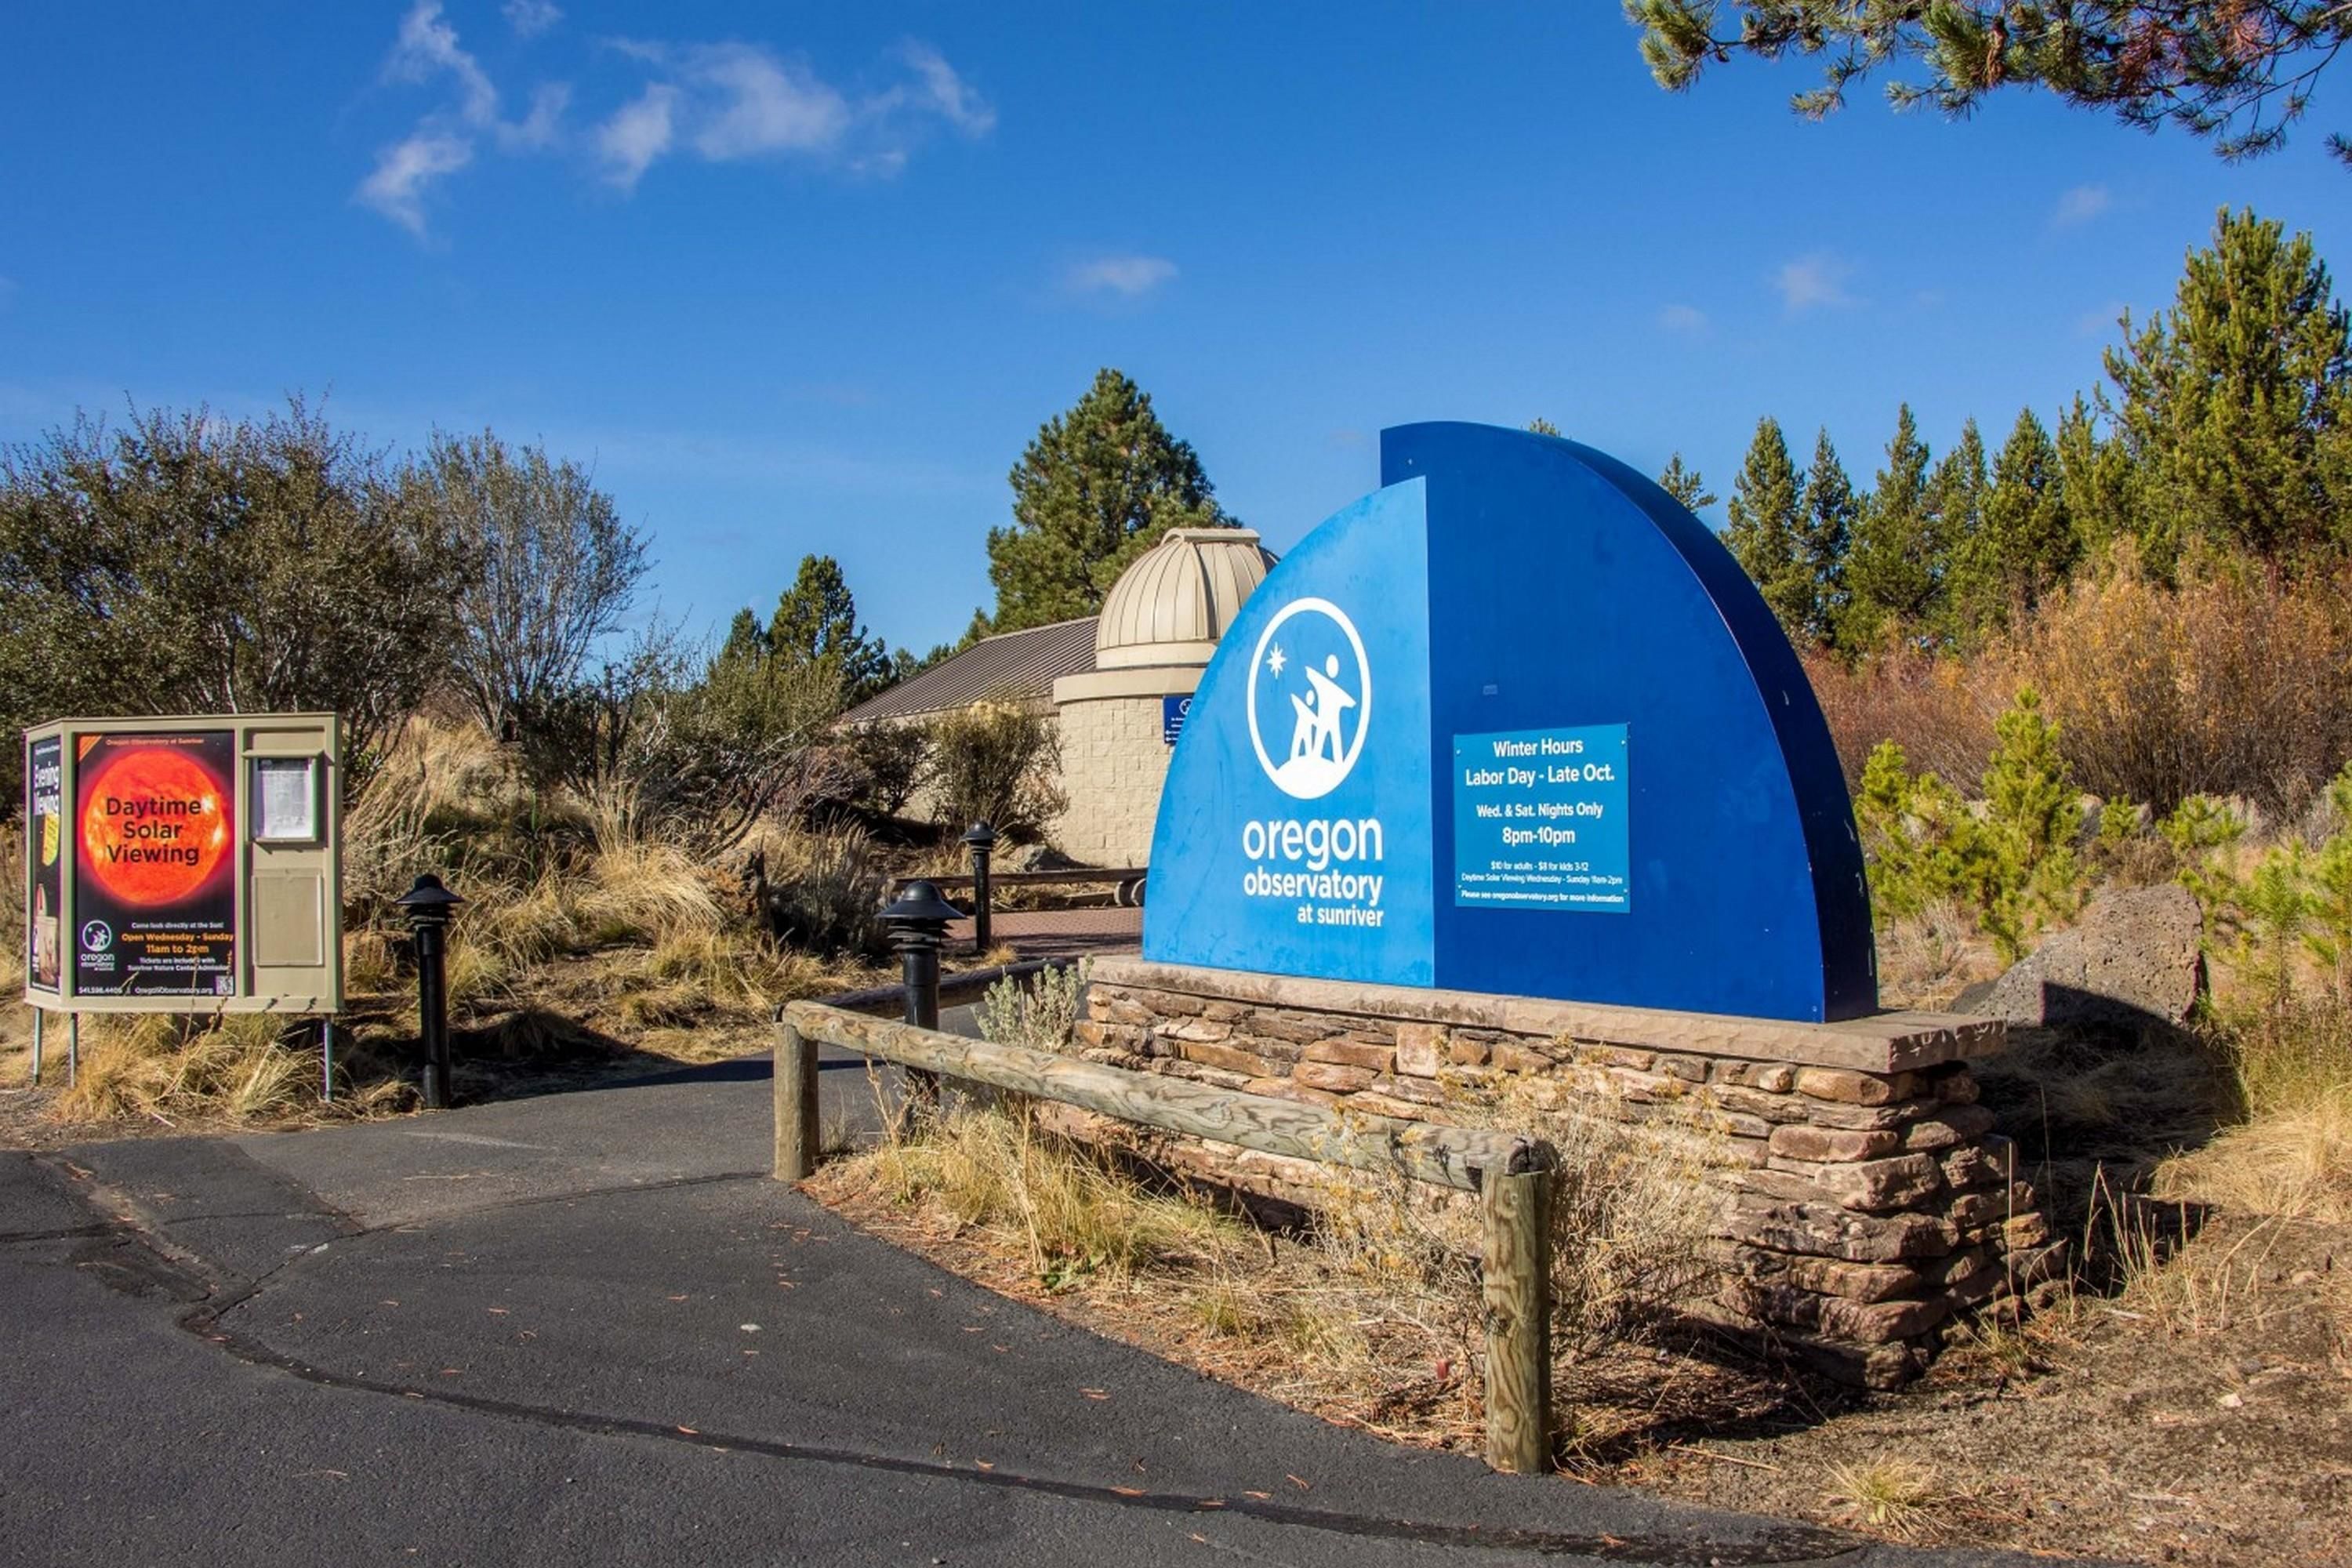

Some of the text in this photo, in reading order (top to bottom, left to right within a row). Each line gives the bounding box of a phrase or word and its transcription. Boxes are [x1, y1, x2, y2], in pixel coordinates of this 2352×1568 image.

[1493, 738, 1584, 757] Winter Hours
[1465, 768, 1504, 786] Labor
[1508, 767, 1536, 788] Day
[1548, 765, 1580, 783] Late
[1584, 763, 1615, 782] Oct.
[106, 797, 201, 818] Daytime
[1476, 801, 1603, 819] Wed. & Sat. Nights Only
[123, 821, 183, 839] Solar
[1502, 826, 1576, 847] 8pm-10pm
[1243, 818, 1383, 871] oregon
[107, 844, 199, 866] Viewing
[1503, 861, 1512, 870] for
[1514, 862, 1533, 871] adults
[1548, 862, 1558, 871] for
[1559, 862, 1573, 871] kids
[1574, 862, 1588, 872] 3-12
[1243, 866, 1383, 907] observatory
[1461, 873, 1485, 884] Daytime
[1486, 873, 1499, 881] Solar
[1501, 873, 1525, 884] Viewing
[1526, 874, 1562, 884] Wednesday
[1566, 875, 1590, 885] Sunday
[1461, 890, 1480, 898] Please
[1570, 894, 1585, 902] more
[1298, 903, 1384, 927] at sunriver
[122, 933, 144, 942] Open
[145, 933, 194, 942] Wednesday
[202, 933, 234, 942] Sunday
[81, 953, 114, 963] oregon
[146, 944, 209, 955] 11am to 2pm
